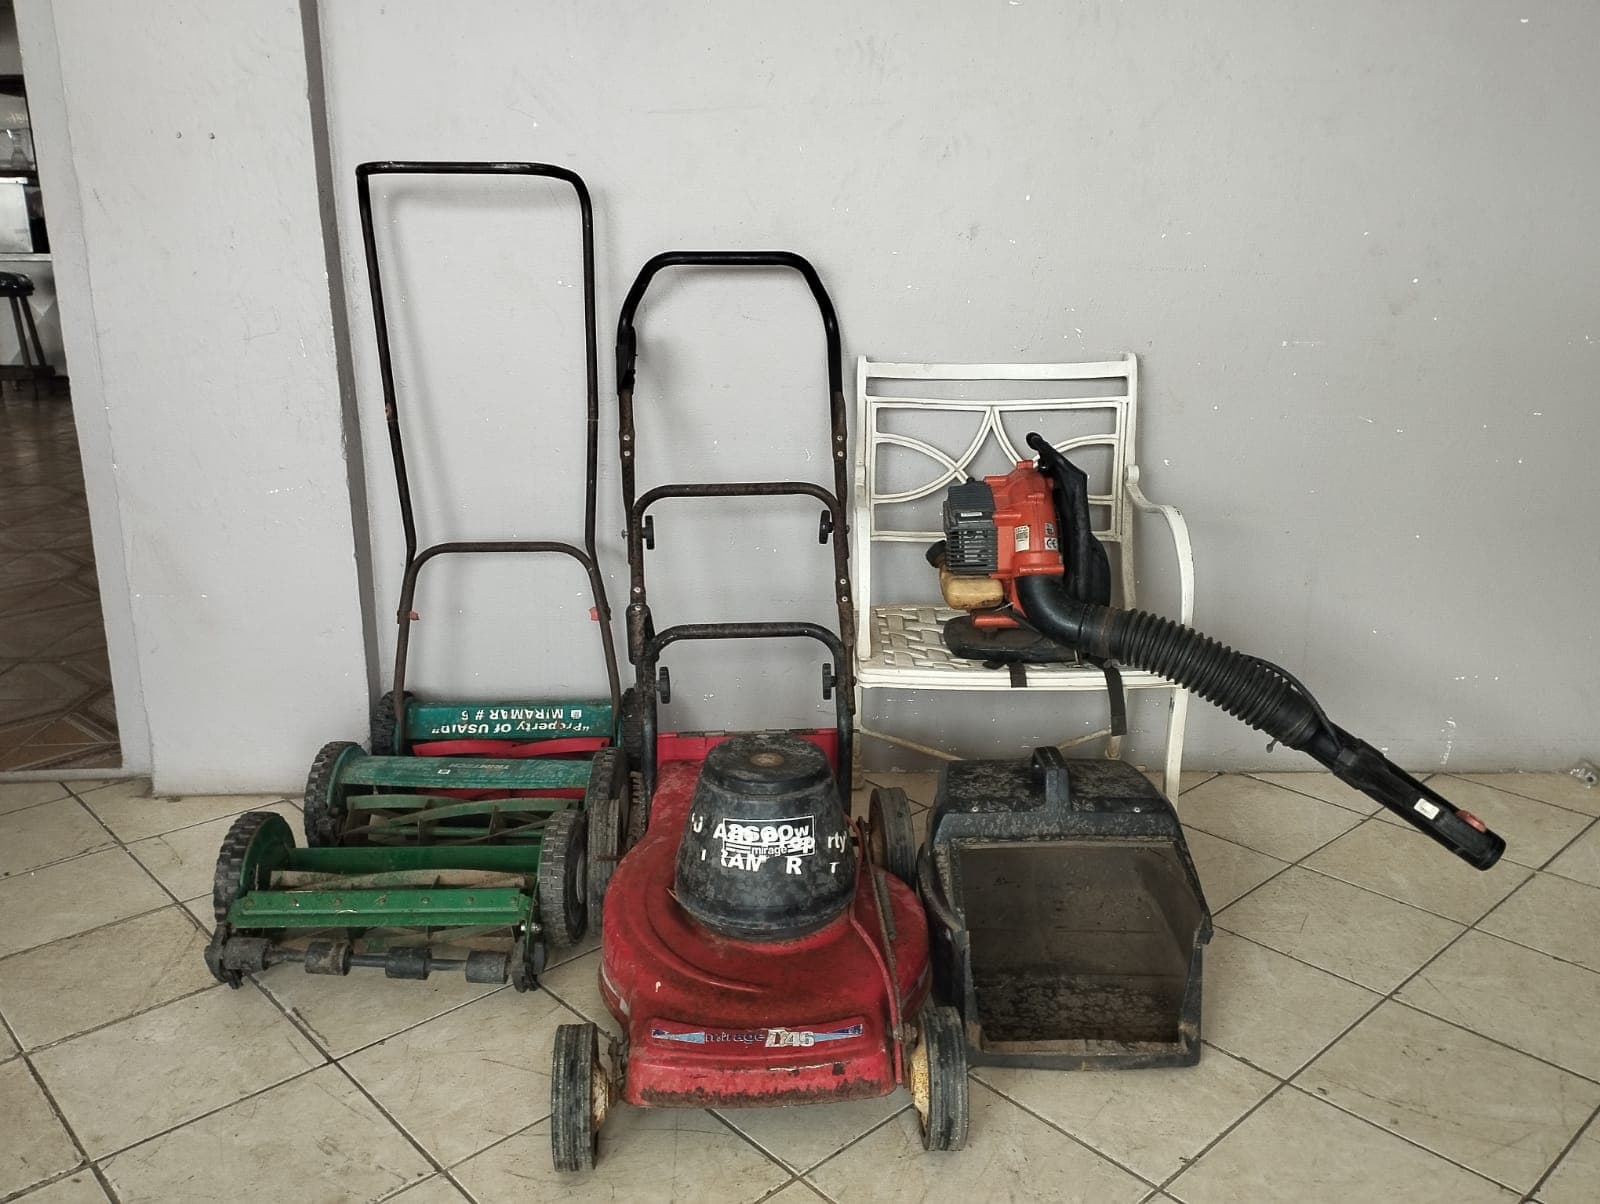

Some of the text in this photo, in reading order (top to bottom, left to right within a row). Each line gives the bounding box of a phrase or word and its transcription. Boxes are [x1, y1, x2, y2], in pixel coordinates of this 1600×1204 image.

[474, 708, 485, 721] #
[489, 708, 564, 720] MIRAMAR
[493, 723, 512, 734] Of
[751, 844, 788, 857] mirage
